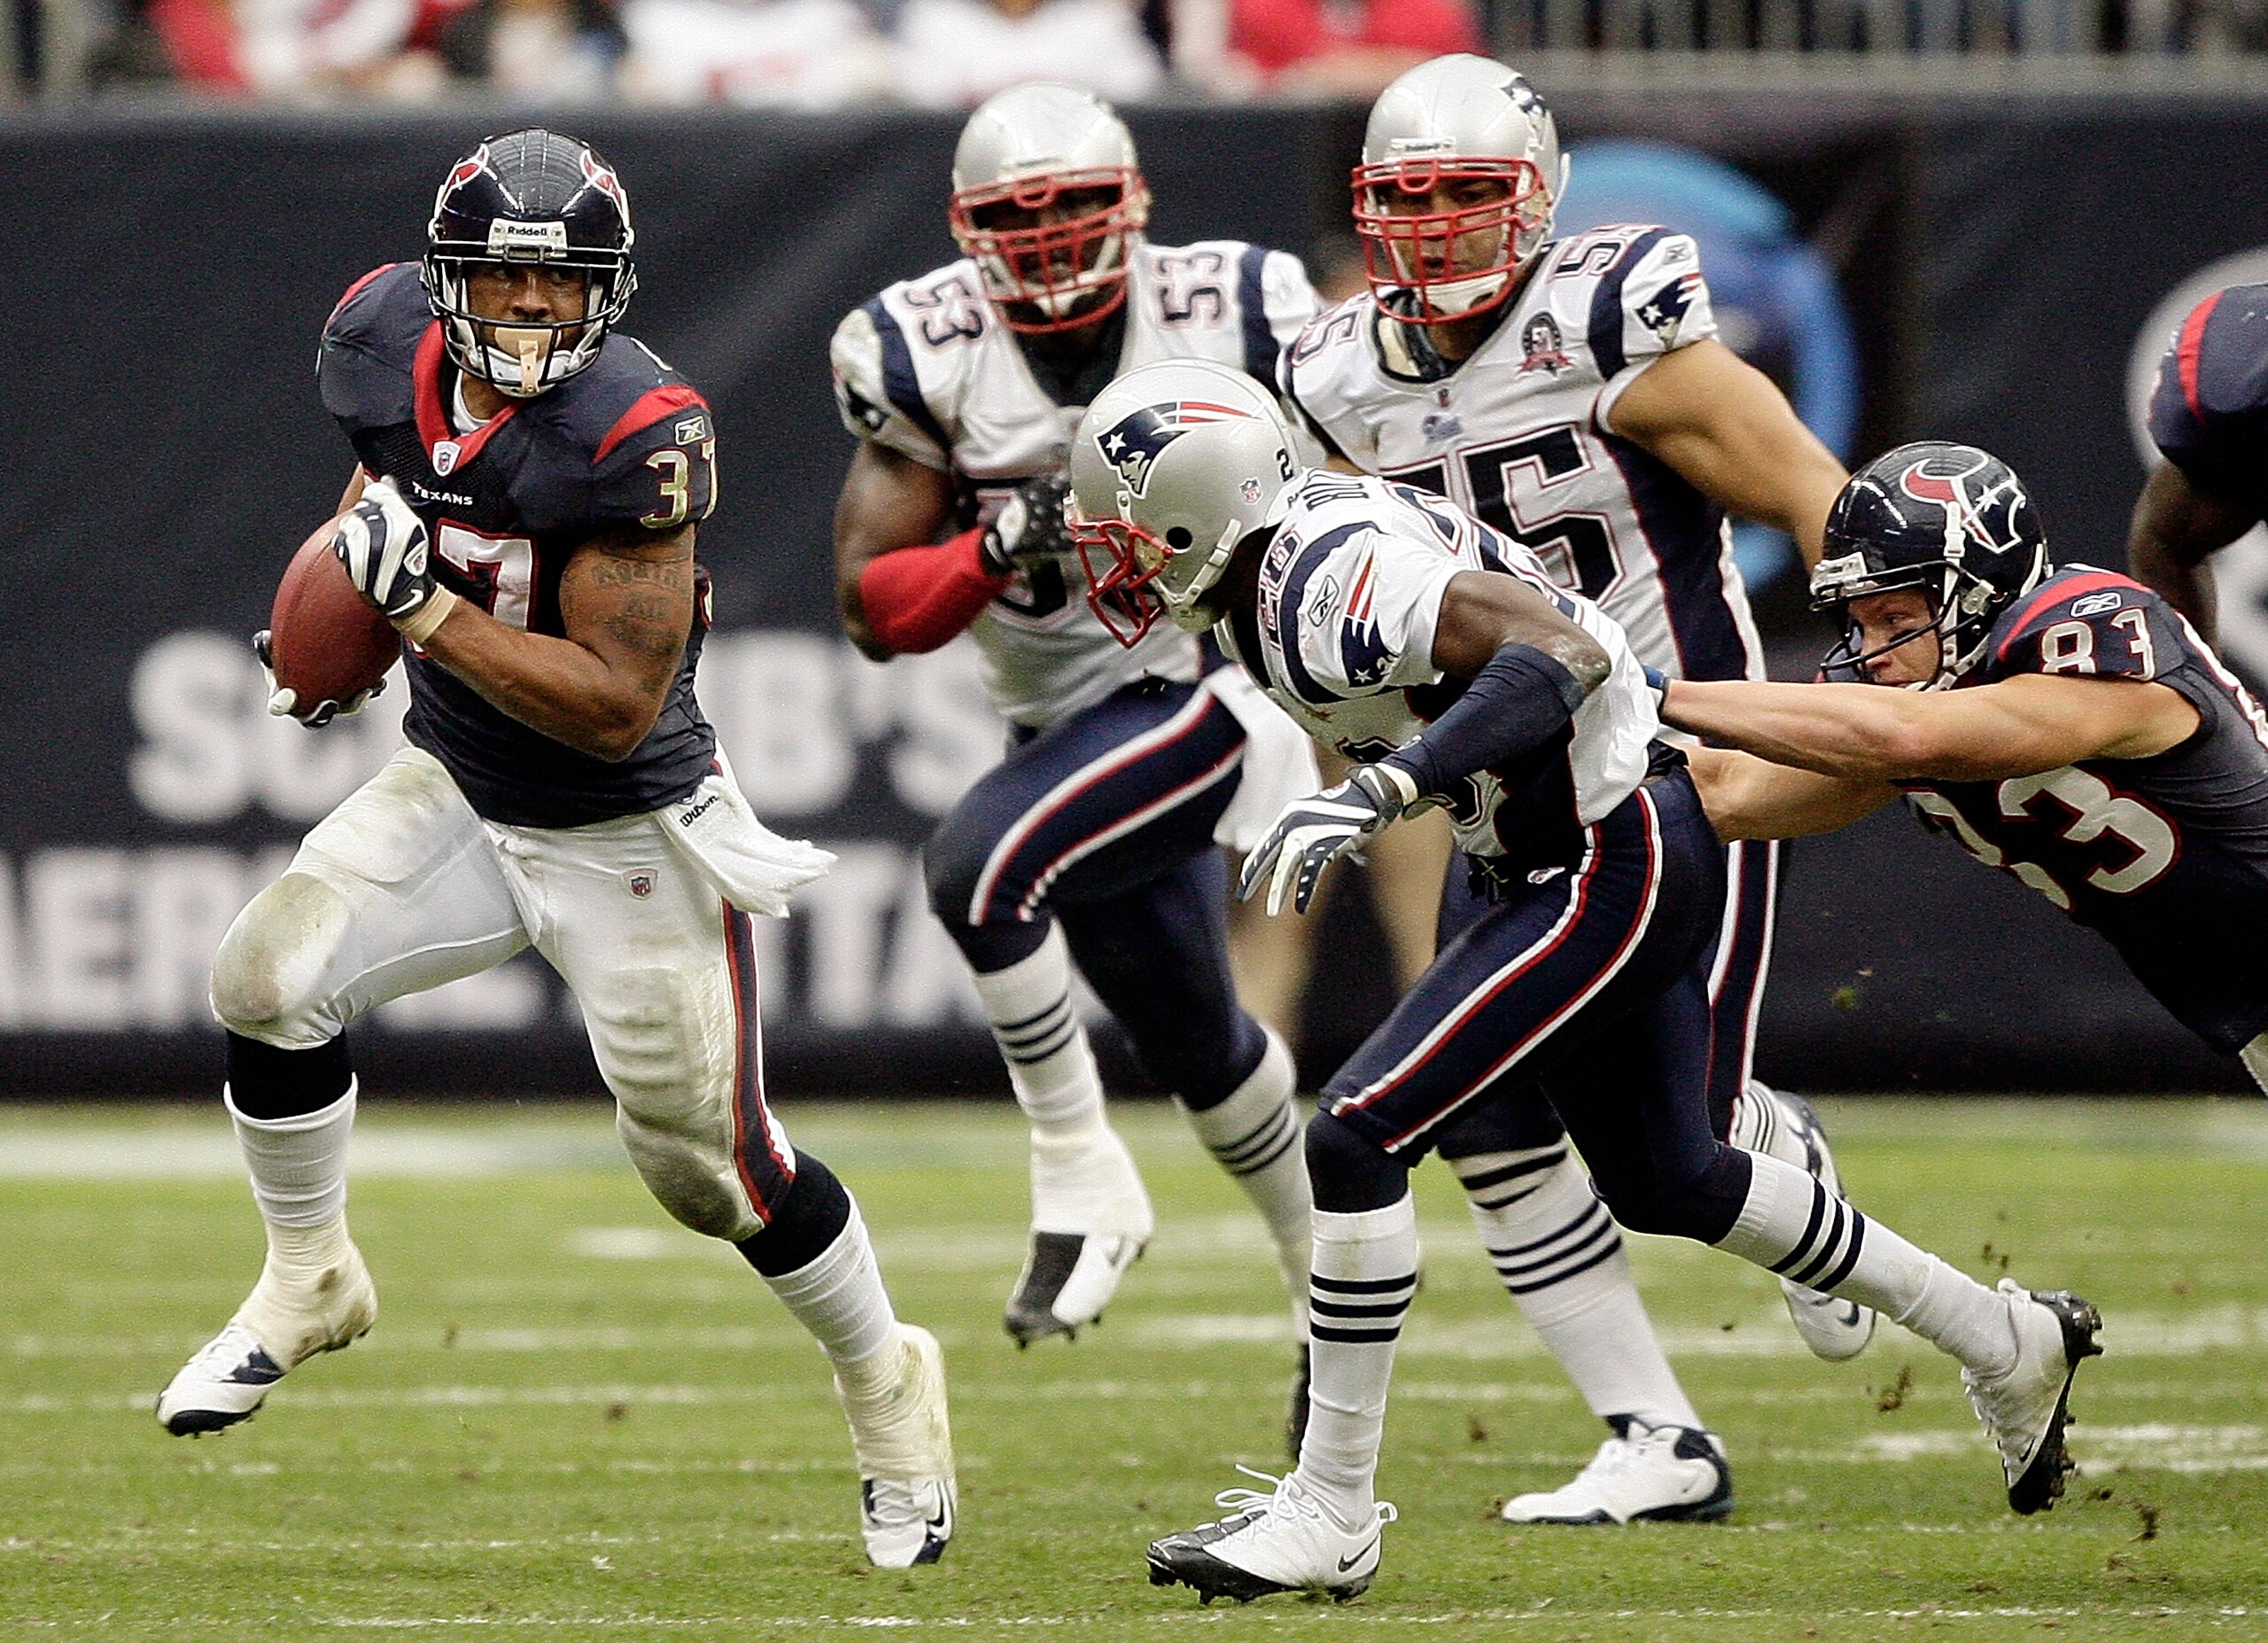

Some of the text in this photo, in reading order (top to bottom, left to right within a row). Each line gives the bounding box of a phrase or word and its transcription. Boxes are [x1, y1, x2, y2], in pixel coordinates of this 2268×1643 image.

[508, 227, 547, 236] Riddell
[902, 273, 986, 349] 53
[1153, 251, 1223, 330] 53
[412, 480, 474, 506] TEXANS
[1379, 422, 1628, 610] 5
[432, 518, 539, 632] 7
[2040, 605, 2156, 681] 83
[680, 795, 720, 827] Wilson
